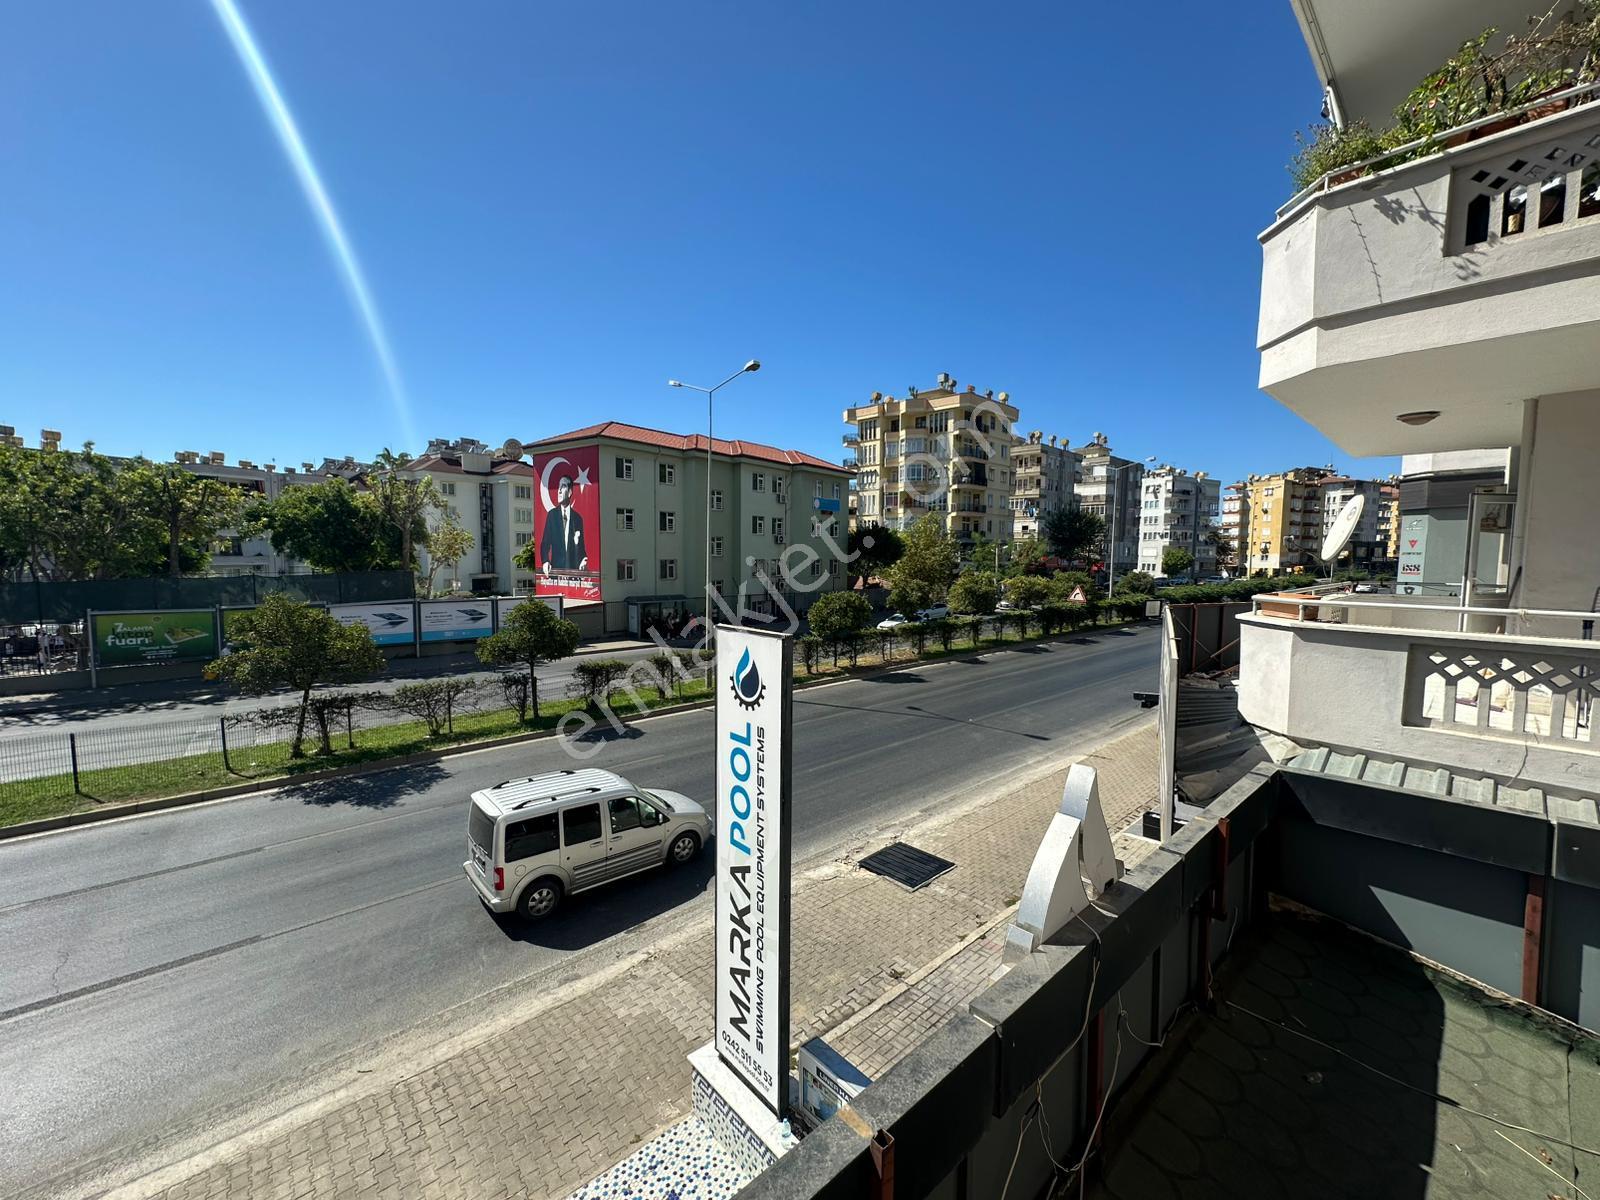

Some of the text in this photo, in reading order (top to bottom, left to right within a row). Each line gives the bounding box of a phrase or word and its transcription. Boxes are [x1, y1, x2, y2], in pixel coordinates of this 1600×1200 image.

[729, 721, 752, 1042] MARKA POOL
[755, 726, 767, 1055] SWIMMING POOL EQUIPMENT SYSTEMS
[721, 1030, 774, 1087] 0242 511 55 53
[819, 1071, 840, 1095] LINER
